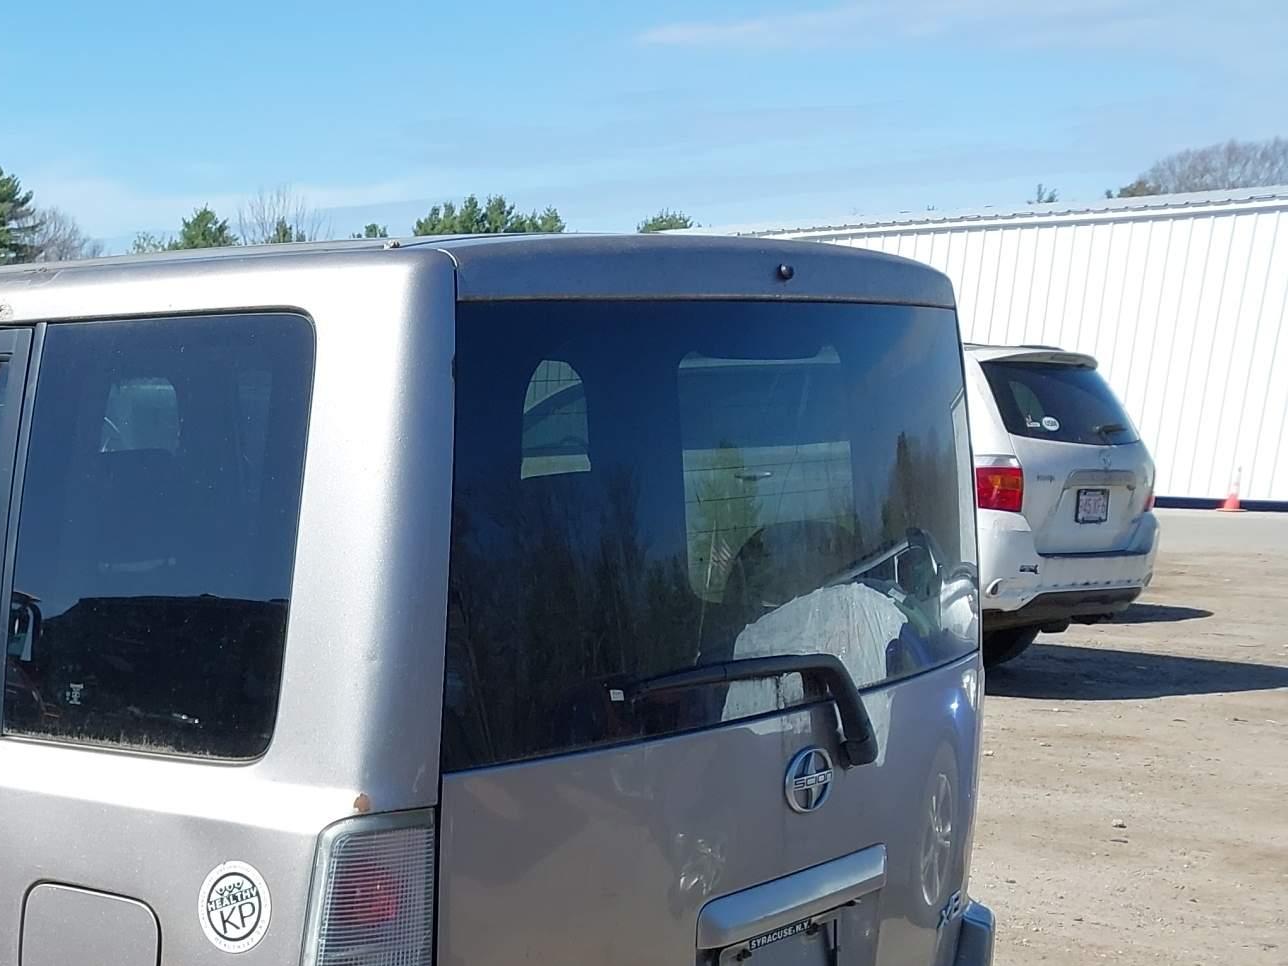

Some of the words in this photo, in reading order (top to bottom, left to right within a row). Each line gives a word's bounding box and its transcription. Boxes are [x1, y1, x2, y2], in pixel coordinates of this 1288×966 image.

[793, 771, 833, 790] SCION
[208, 886, 257, 912] HEALTHY
[220, 902, 255, 933] KP
